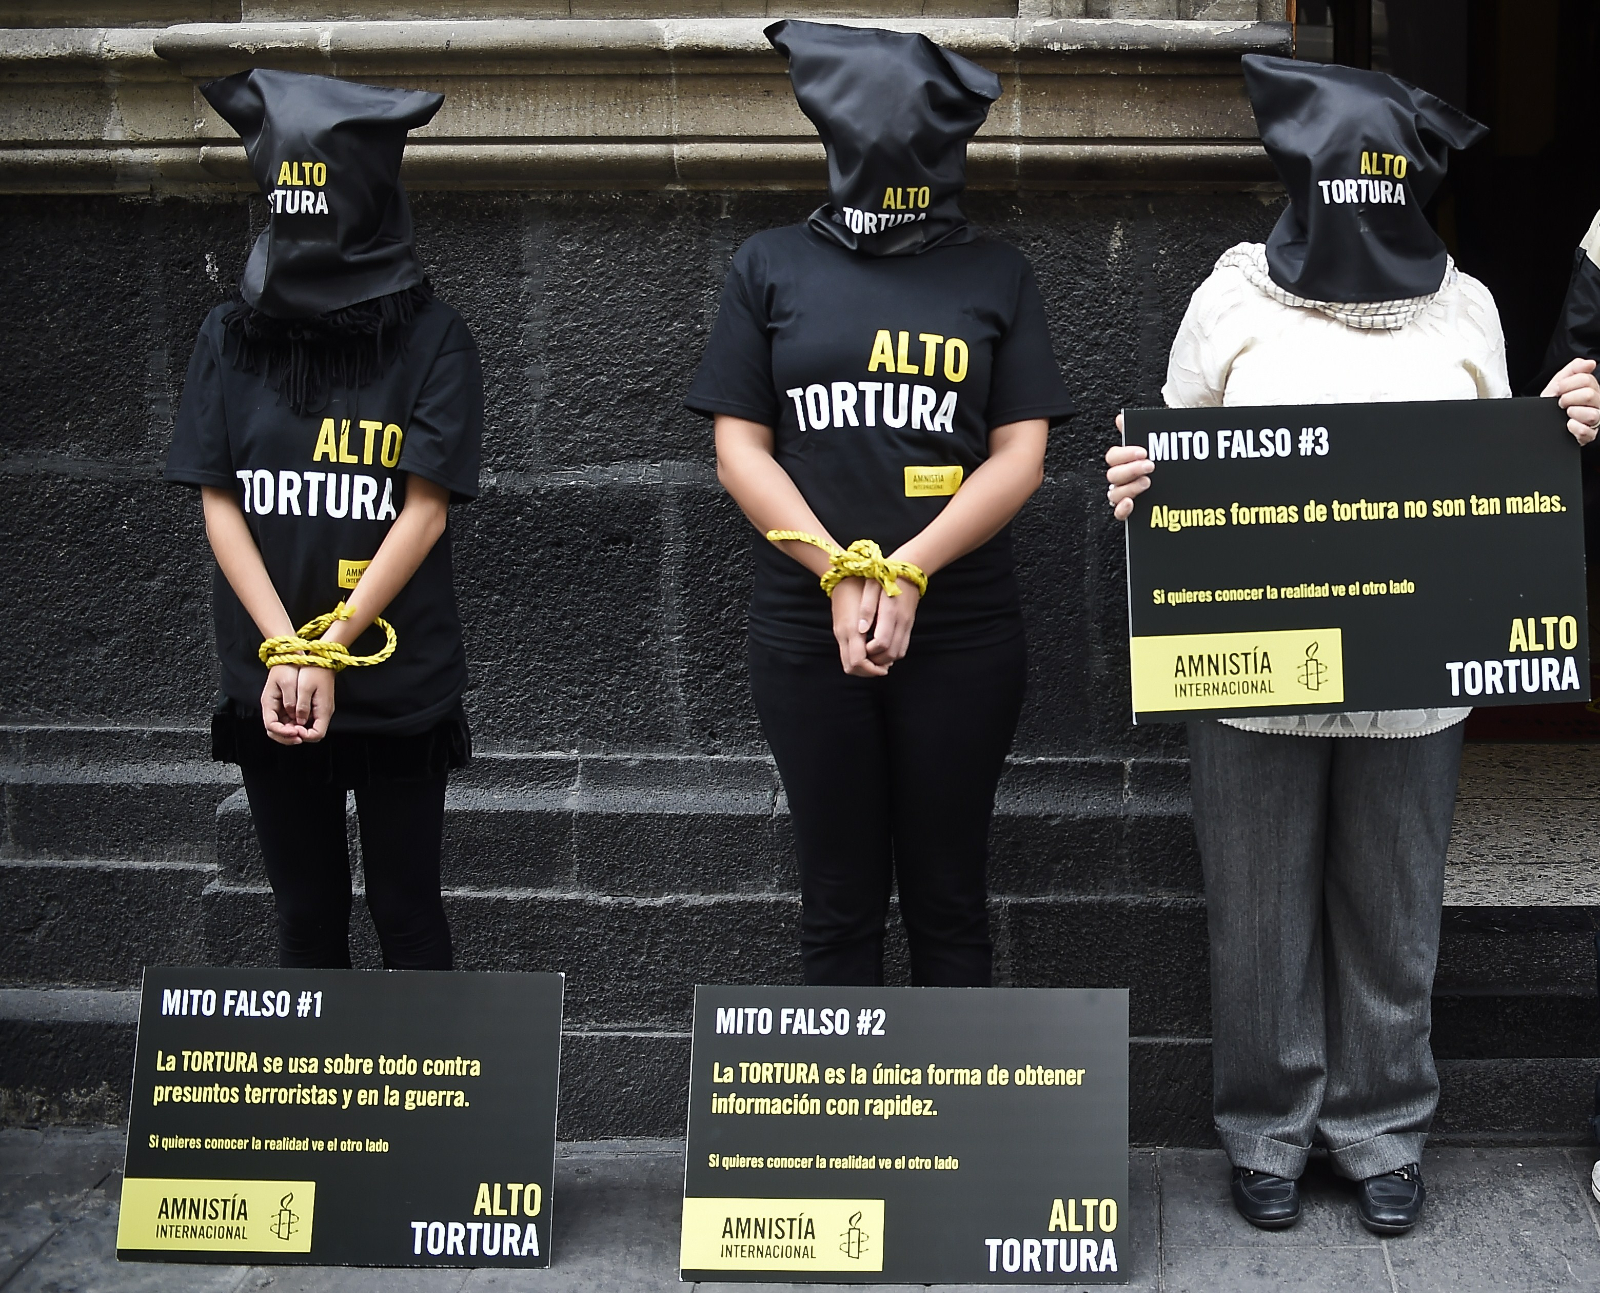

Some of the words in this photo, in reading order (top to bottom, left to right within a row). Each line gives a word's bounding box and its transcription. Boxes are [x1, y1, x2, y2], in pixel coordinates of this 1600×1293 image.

[278, 161, 327, 186] ALTO
[1360, 151, 1407, 179] ALTO
[883, 186, 929, 210] ALTO
[1318, 179, 1405, 205] TORTURA
[868, 330, 968, 382] ALTO
[786, 381, 958, 433] TORTURA
[313, 418, 403, 468] ALTO
[1148, 431, 1209, 461] MITO
[1217, 428, 1291, 458] FALSO
[1298, 427, 1329, 457] #3
[236, 469, 396, 520] TORTURA
[1150, 505, 1226, 532] Algunas
[1231, 501, 1299, 524] formas
[1304, 500, 1327, 522] de
[1332, 498, 1399, 522] tortura
[1404, 501, 1427, 519] no
[1432, 499, 1465, 518] son
[1470, 494, 1500, 516] tan
[1506, 491, 1567, 514] malas.
[1153, 589, 1165, 604] Si
[1167, 589, 1212, 607] quieres
[1215, 586, 1264, 602] conocer
[1267, 585, 1278, 600] la
[1280, 583, 1329, 600] realidad
[1331, 585, 1346, 597] ve
[1349, 582, 1359, 596] el
[1362, 582, 1387, 596] otro
[1389, 580, 1415, 595] lado
[1509, 615, 1578, 653] ALTO
[1174, 646, 1272, 678] AMNISTÍA
[1174, 680, 1274, 698] INTERNACIONAL
[1446, 657, 1579, 696] TORTURA
[161, 989, 215, 1017] MITO
[223, 990, 290, 1017] FALSO
[296, 992, 323, 1017] #1
[716, 1007, 772, 1035] MITO
[780, 1008, 850, 1035] FALSO
[856, 1009, 885, 1036] #2
[157, 1051, 176, 1072] La
[181, 1051, 257, 1073] TORTURA
[263, 1058, 283, 1074] se
[288, 1058, 318, 1074] usa
[324, 1055, 373, 1075] sobre
[378, 1056, 417, 1076] todo
[422, 1058, 481, 1076] contra
[713, 1061, 734, 1083] La
[739, 1063, 819, 1084] TORTURA
[825, 1068, 845, 1084] es
[850, 1063, 867, 1084] la
[872, 1063, 921, 1085] única
[927, 1065, 982, 1085] forma
[987, 1065, 1009, 1086] de
[1014, 1065, 1085, 1086] obtener
[154, 1085, 239, 1106] presuntos
[244, 1084, 337, 1105] terroristas
[342, 1089, 352, 1109] y
[357, 1089, 379, 1106] en
[383, 1086, 400, 1106] la
[404, 1090, 470, 1110] guerra.
[712, 1093, 820, 1114] información
[825, 1099, 859, 1115] con
[864, 1096, 938, 1119] rapidez.
[149, 1134, 159, 1149] Si
[161, 1134, 202, 1151] quieres
[204, 1137, 249, 1150] conocer
[251, 1136, 262, 1150] la
[264, 1136, 309, 1151] realidad
[311, 1140, 325, 1151] ve
[327, 1138, 338, 1152] el
[340, 1139, 362, 1152] otro
[365, 1139, 389, 1152] lado
[709, 1154, 720, 1168] Si
[722, 1155, 764, 1171] quieres
[767, 1156, 814, 1169] conocer
[816, 1155, 827, 1169] la
[829, 1155, 876, 1169] realidad
[878, 1159, 892, 1169] ve
[895, 1156, 905, 1169] el
[908, 1157, 931, 1170] otro
[934, 1156, 959, 1170] lado
[157, 1194, 248, 1221] AMNISTÍA
[474, 1182, 542, 1217] ALTO
[722, 1212, 815, 1240] AMNISTÍA
[1049, 1199, 1117, 1233] ALTO
[156, 1225, 247, 1240] INTERNACIONAL
[411, 1221, 539, 1256] TORTURA
[720, 1244, 816, 1259] INTERNACIONAL
[985, 1238, 1117, 1272] TORTURA
